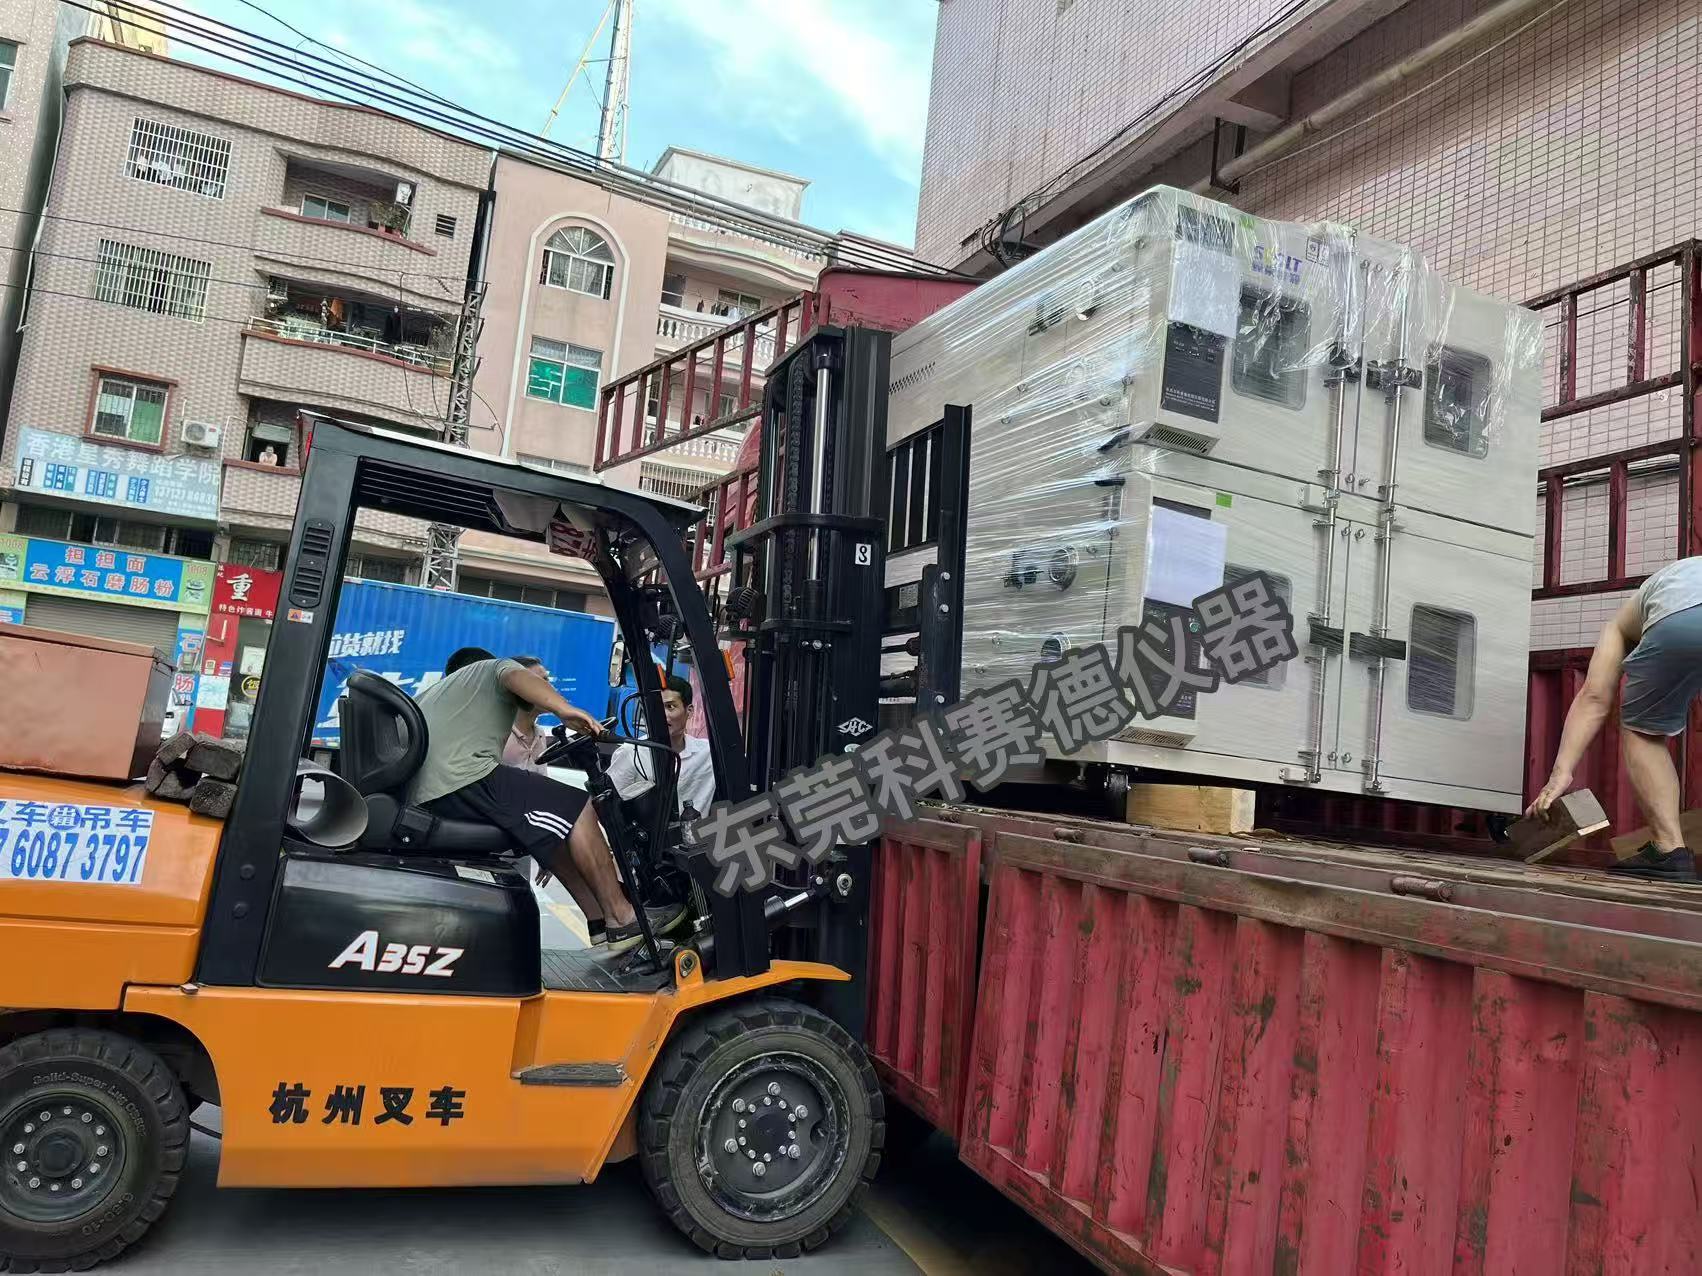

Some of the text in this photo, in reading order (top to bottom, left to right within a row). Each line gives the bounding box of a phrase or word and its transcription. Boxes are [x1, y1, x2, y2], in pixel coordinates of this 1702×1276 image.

[65, 546, 147, 574] 担担面
[30, 562, 174, 597] 云浮石磨肠粉
[226, 572, 253, 602] 重
[269, 1082, 466, 1126] 杭州叉车
